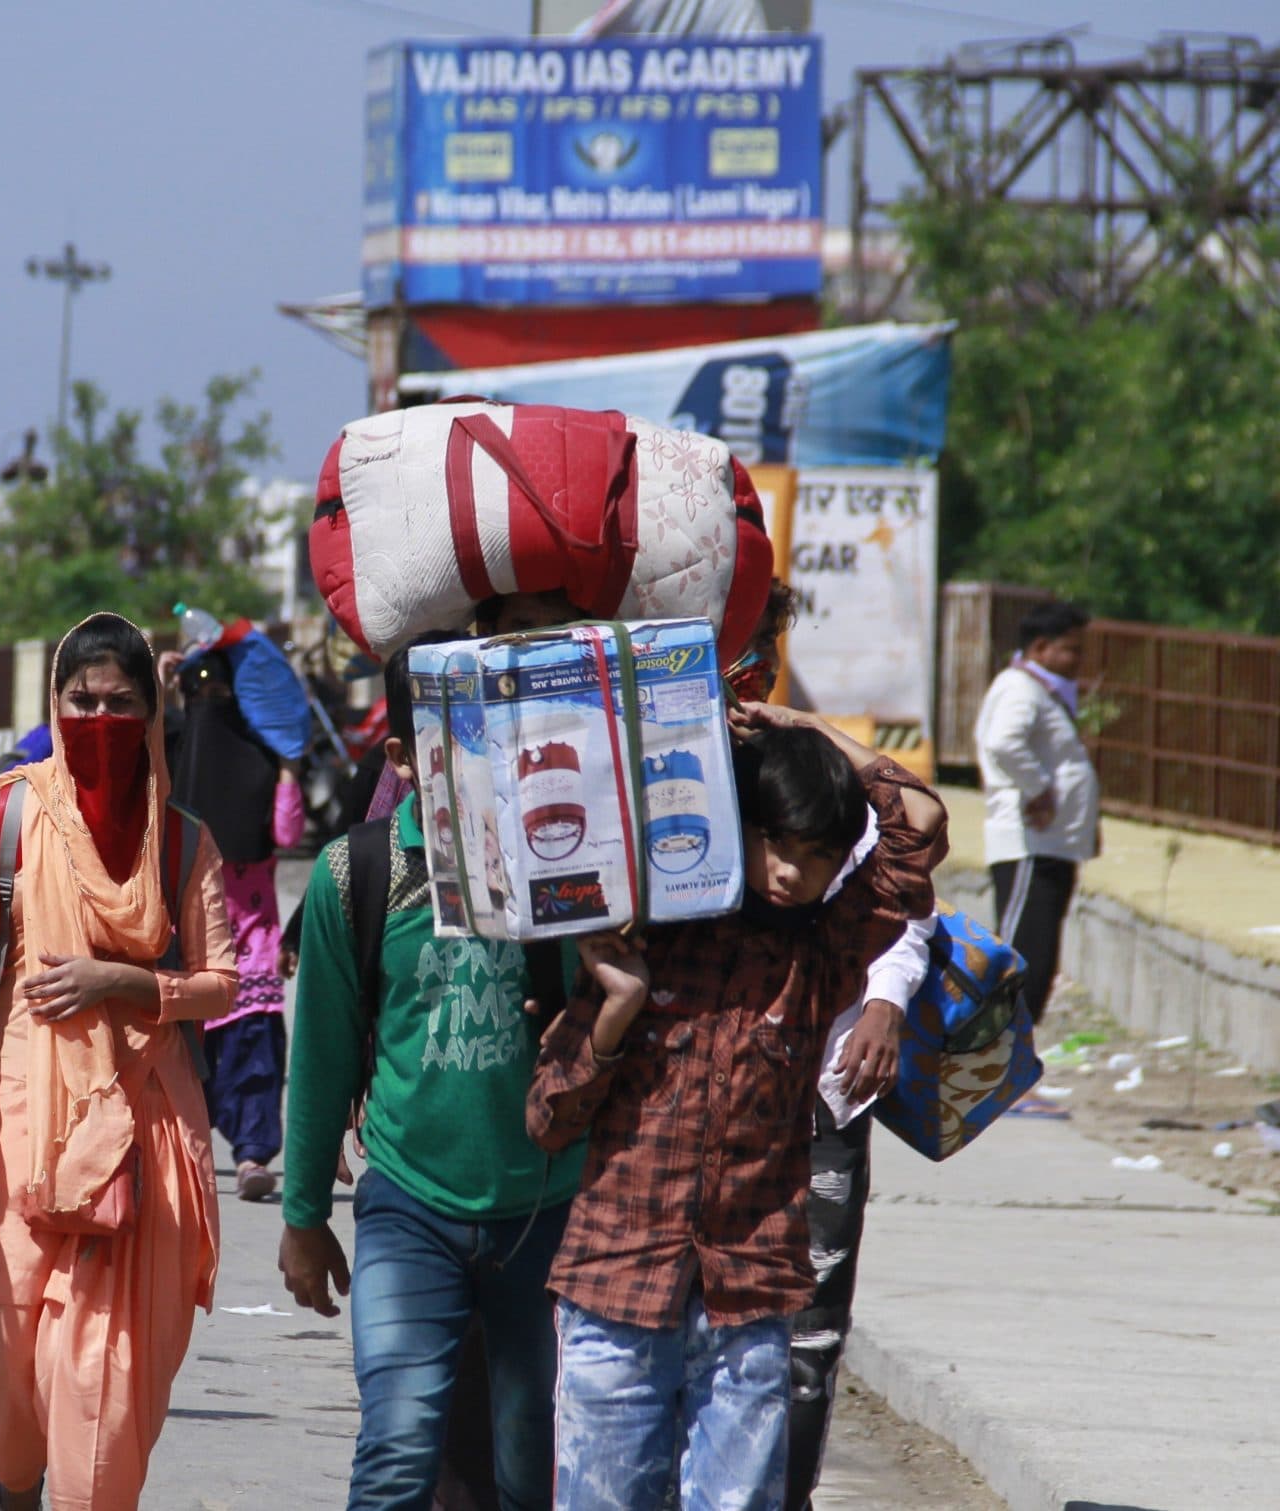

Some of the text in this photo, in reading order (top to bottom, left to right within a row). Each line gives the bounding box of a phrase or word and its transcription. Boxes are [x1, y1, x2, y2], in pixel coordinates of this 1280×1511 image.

[413, 50, 565, 94] VAJIRAO
[572, 48, 632, 92] IAS
[638, 45, 811, 91] ACADEMY
[465, 96, 517, 121] IAS
[542, 96, 595, 121] IPS
[621, 94, 671, 120] IFS
[694, 92, 760, 119] PCS
[608, 184, 670, 219] Station
[636, 645, 705, 676] Booster
[531, 680, 550, 690] JUG
[550, 675, 582, 687] WATER
[665, 881, 699, 892] ALWAYS
[415, 936, 527, 984] APNA
